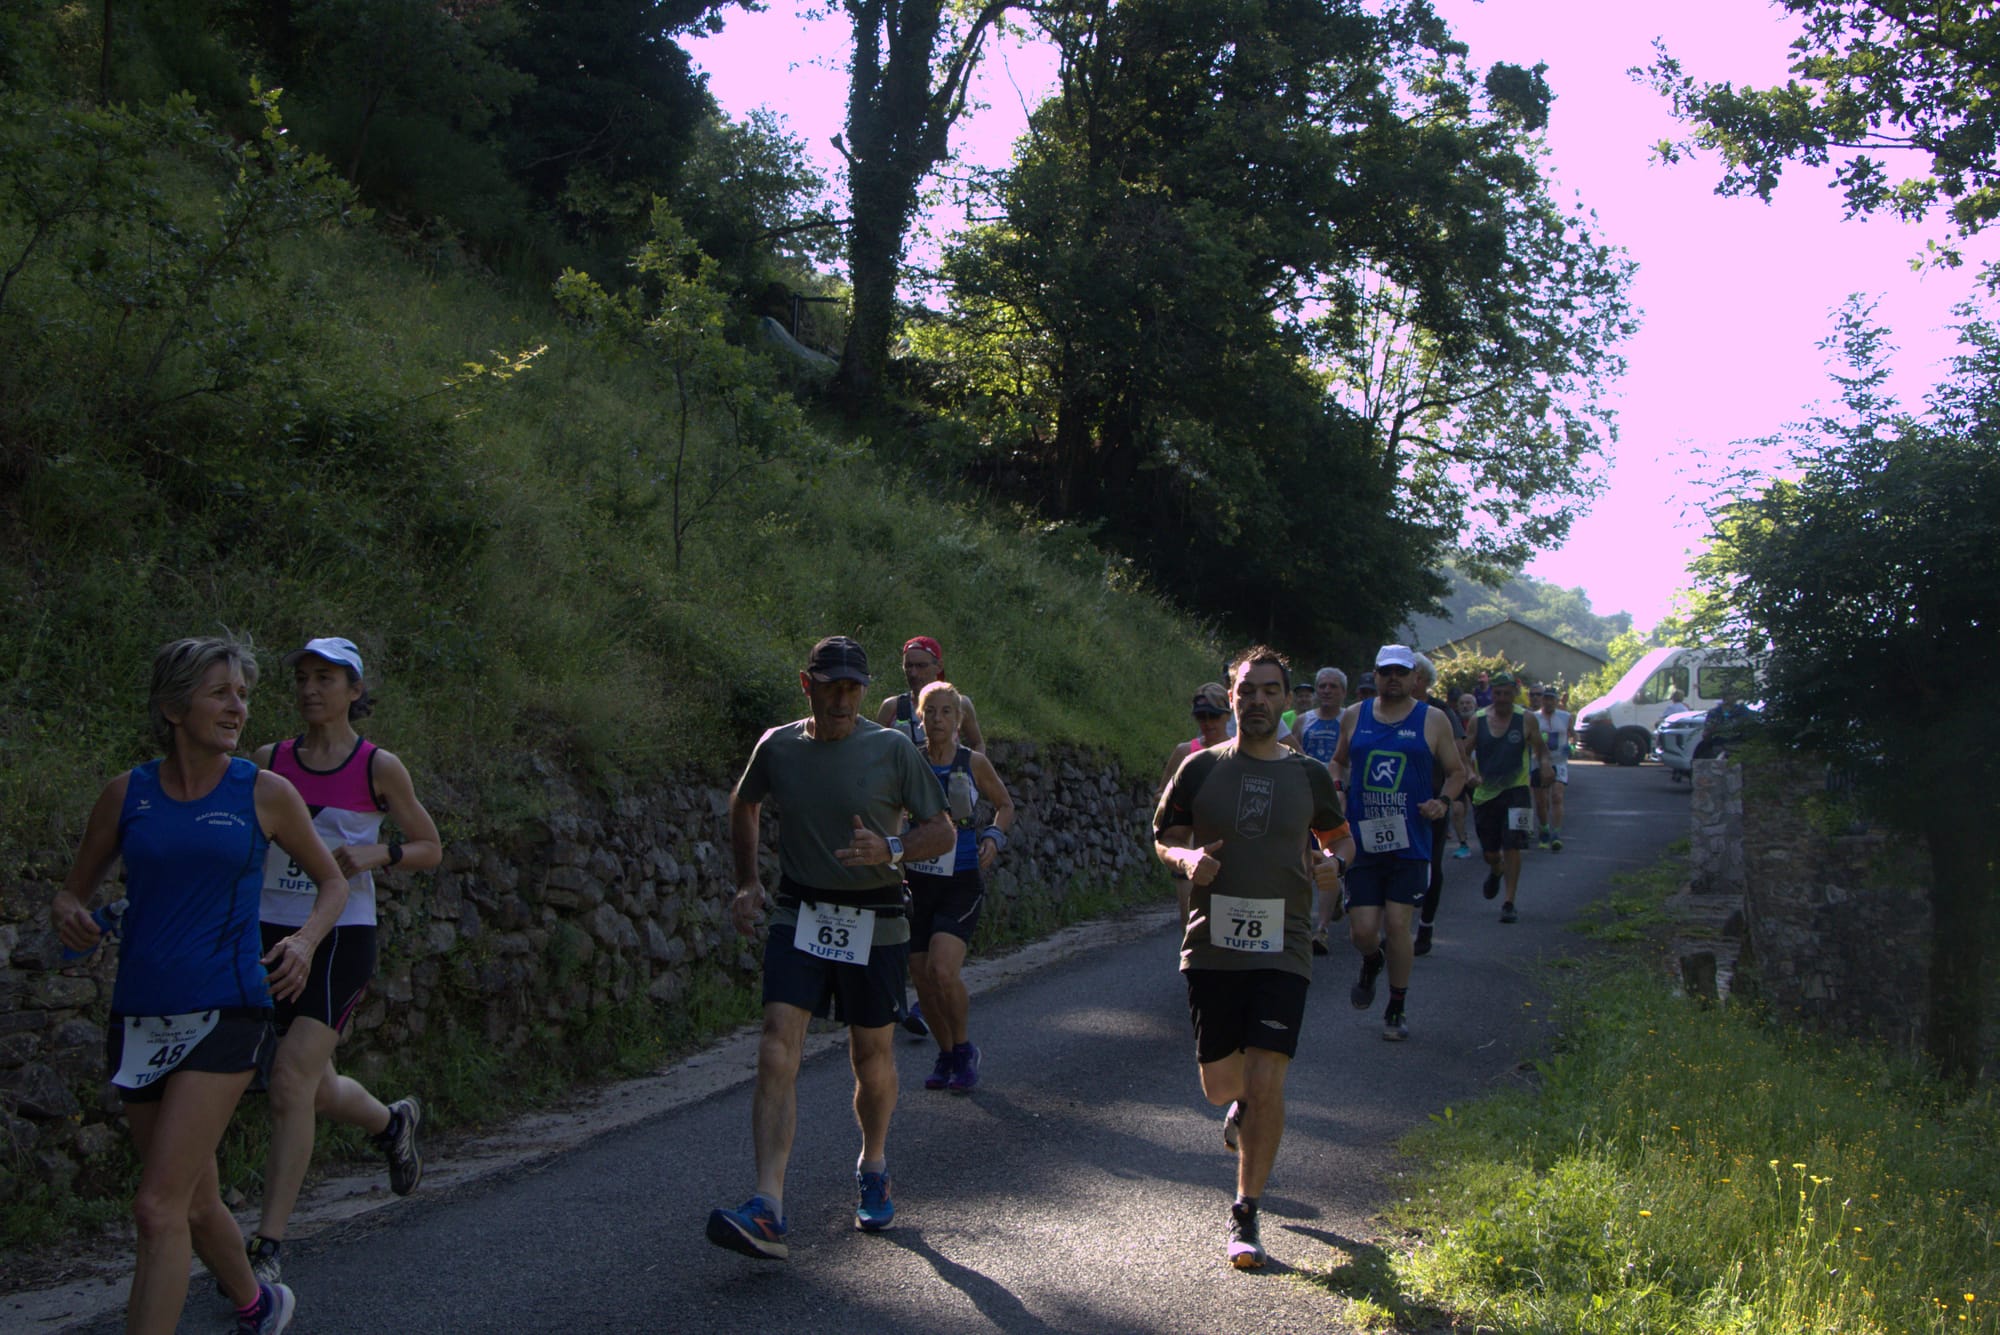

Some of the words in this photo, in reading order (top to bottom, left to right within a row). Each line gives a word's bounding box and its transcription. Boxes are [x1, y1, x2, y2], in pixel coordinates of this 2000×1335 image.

[1362, 792, 1408, 806] CHALLENGE
[1375, 830, 1394, 844] 50
[287, 857, 303, 878] 5
[278, 878, 314, 891] TUFF
[818, 926, 849, 948] 63
[1231, 918, 1262, 938] 78
[808, 942, 855, 961] TUFF'S
[1223, 936, 1270, 950] TUFF'S
[148, 1043, 186, 1068] 48
